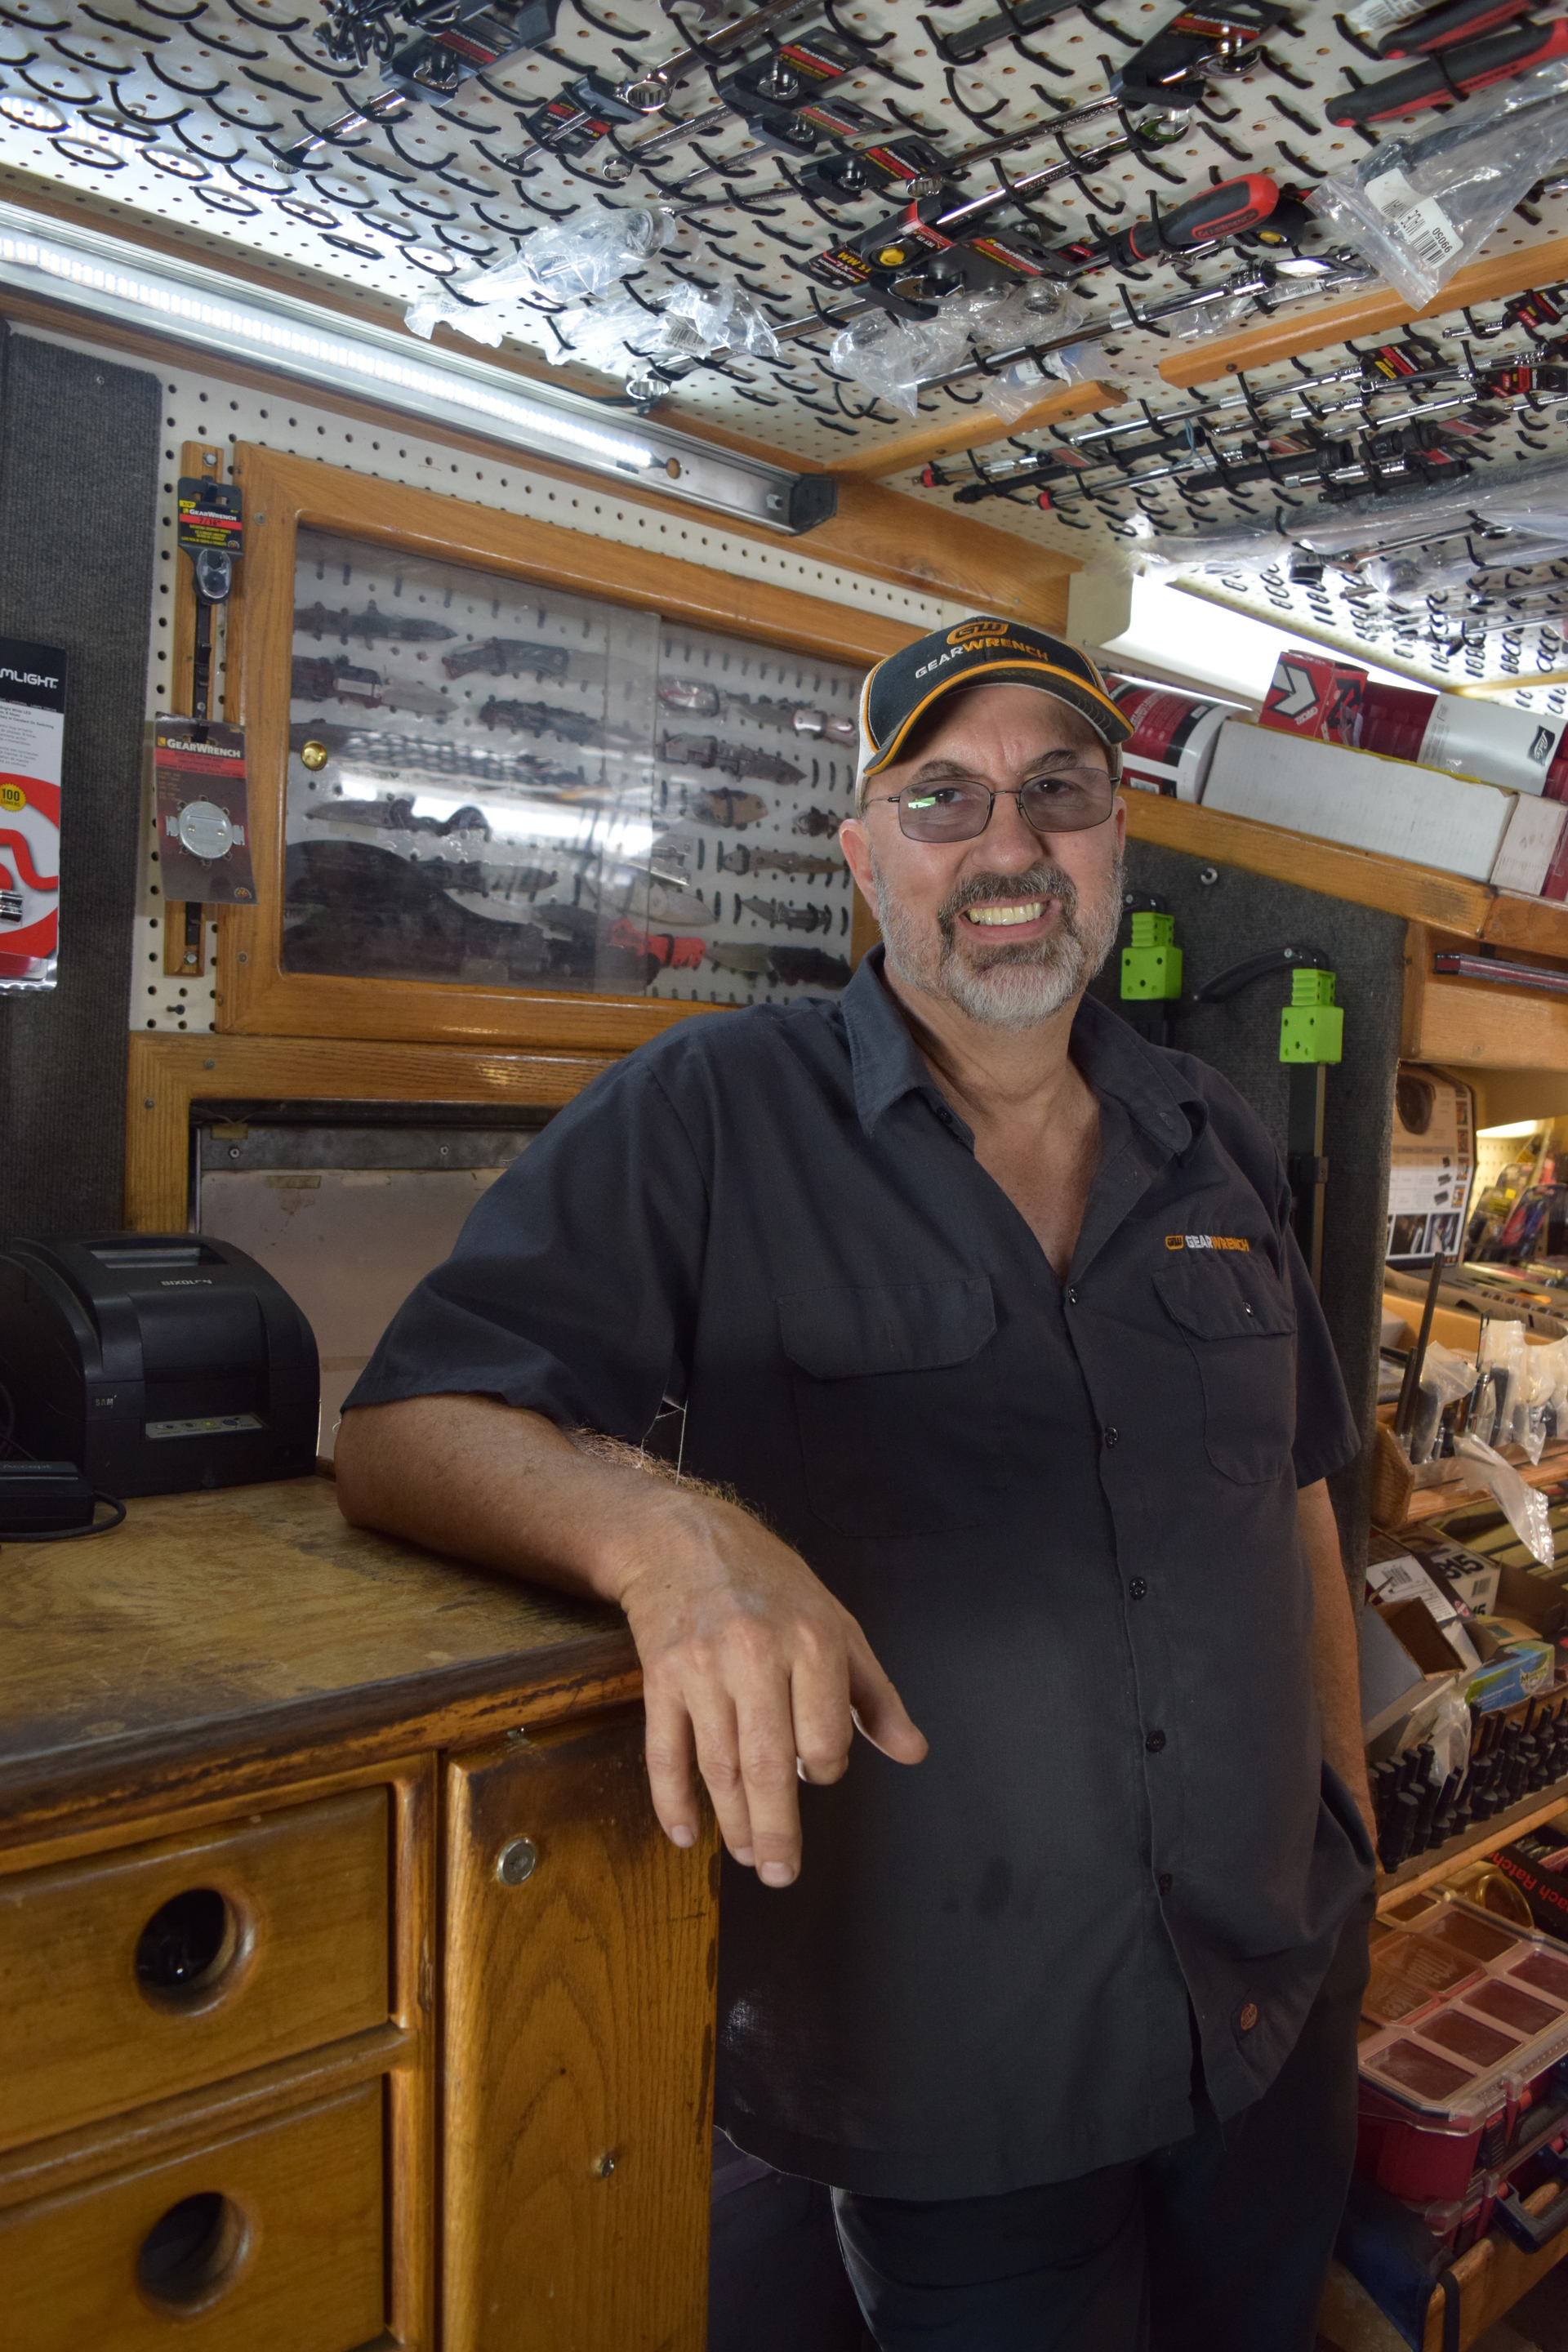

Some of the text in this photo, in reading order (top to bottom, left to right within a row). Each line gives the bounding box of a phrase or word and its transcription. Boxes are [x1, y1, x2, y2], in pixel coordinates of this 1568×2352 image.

[450, 29, 500, 56] GEARWRENCH
[800, 47, 847, 71] GEARWRENCH
[818, 109, 860, 131] GEARWRENCH
[887, 150, 921, 175] GEARWRENCH
[922, 238, 936, 248] TRY
[1432, 227, 1453, 254] 99050
[835, 258, 853, 273] XL
[836, 251, 861, 267] MM
[993, 243, 1045, 271] GEARWRENCH
[817, 258, 856, 281] GEARWRENCH
[189, 509, 237, 521] GEARWRENCH
[199, 517, 221, 526] 7/16"
[915, 638, 1049, 679] GEARWRENCH
[167, 738, 241, 758] GEARWRENCH
[1, 799, 21, 808] LUMENS
[2, 788, 20, 802] 100
[1185, 1235, 1250, 1251] GEARWRENCH
